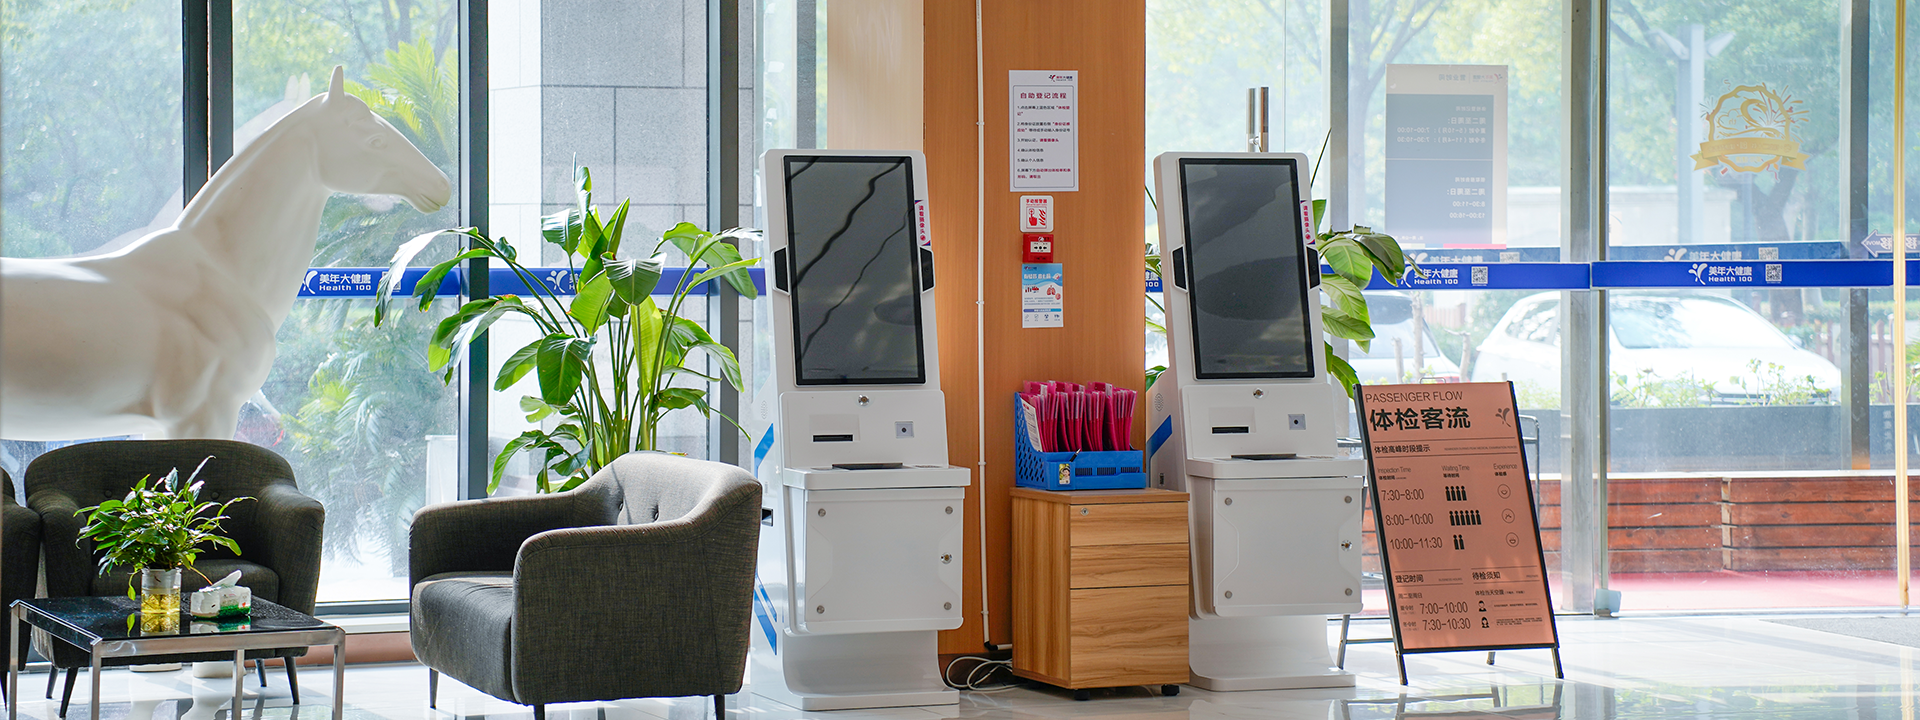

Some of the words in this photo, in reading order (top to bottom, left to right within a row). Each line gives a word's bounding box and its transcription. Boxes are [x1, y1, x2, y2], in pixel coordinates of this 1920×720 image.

[1708, 266, 1752, 276] 美年大健康
[319, 274, 371, 284] 美年大健康
[1365, 392, 1430, 403] PASSENGER
[1433, 391, 1463, 401] FLOW
[1370, 407, 1471, 431] 体检客流
[1374, 444, 1430, 454] 体检高峰时段提示
[1381, 488, 1424, 501] 7:30-8:00
[1385, 513, 1434, 526] 8:00-10:00
[1390, 537, 1442, 549] 10:00-11:30
[1395, 574, 1424, 583] 登记时间
[1472, 571, 1500, 580] 待检须知
[1420, 601, 1468, 614] 7:00-10:00
[1422, 618, 1470, 630] 7:30-10:30
